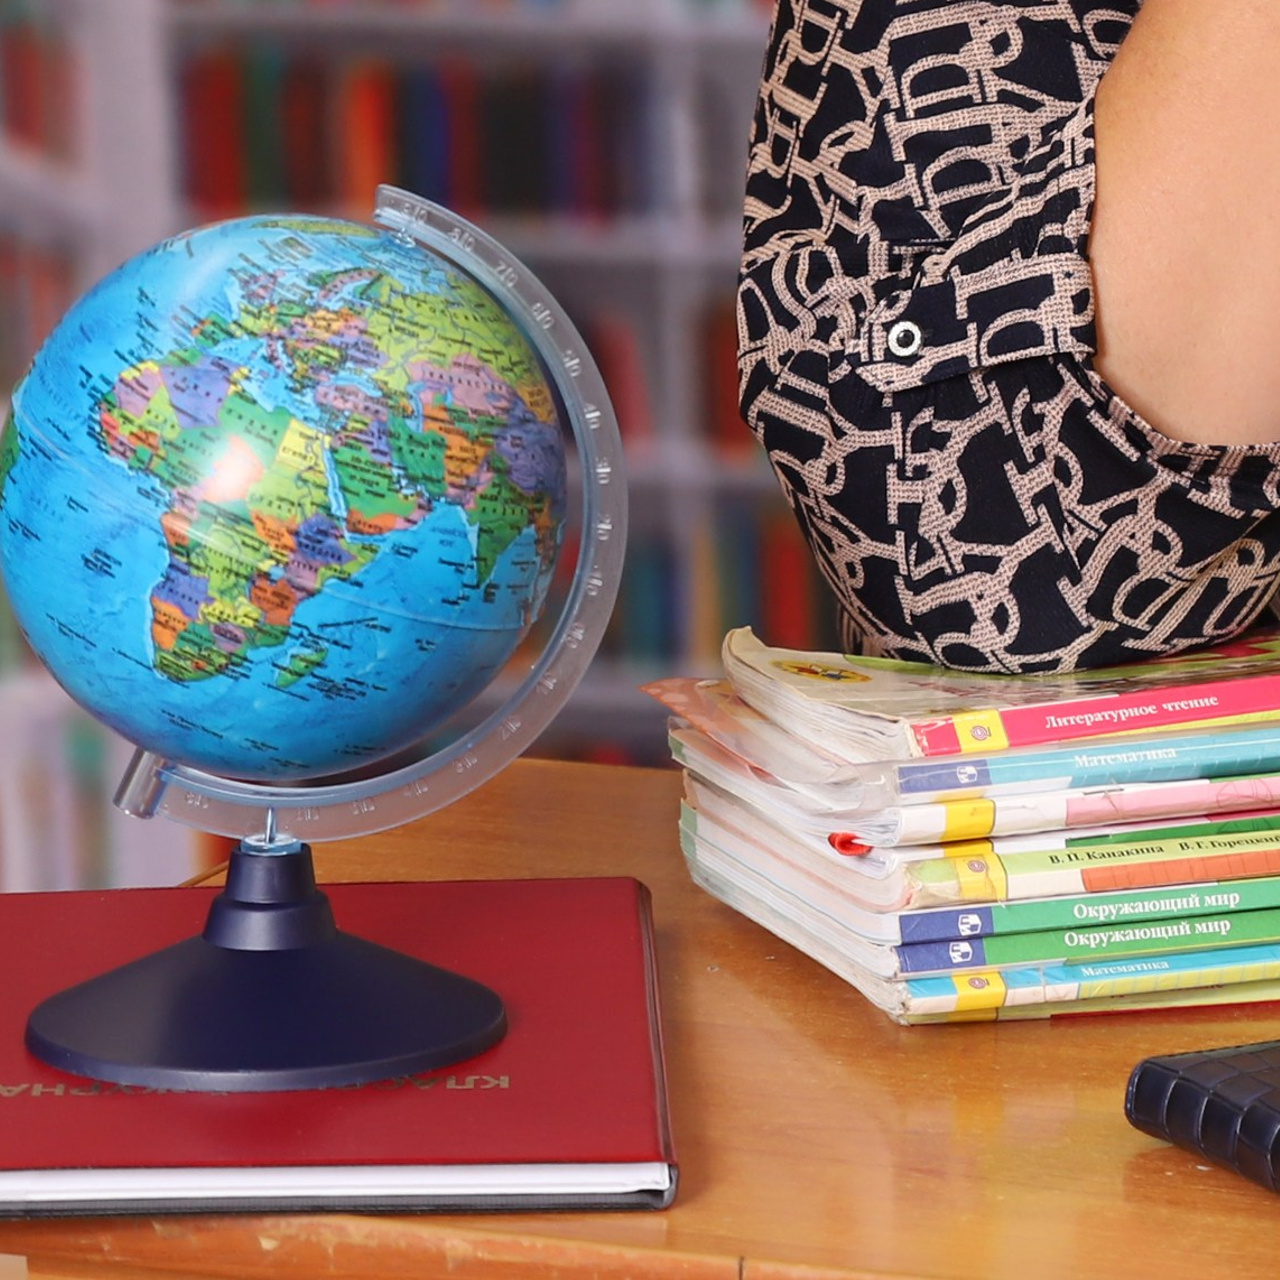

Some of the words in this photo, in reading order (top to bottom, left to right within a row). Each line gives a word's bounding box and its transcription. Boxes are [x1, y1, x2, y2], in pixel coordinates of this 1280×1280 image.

[1045, 699, 1157, 730] Литературное
[1162, 695, 1218, 712] чтение
[1073, 747, 1177, 768] Математика
[1049, 852, 1066, 865] В.
[1087, 844, 1165, 862] Канакина
[1073, 892, 1201, 921] Окружающий
[1204, 890, 1240, 911] мир
[1064, 919, 1192, 948] Окружающий
[1195, 918, 1231, 939] мир
[1081, 960, 1170, 977] Математика
